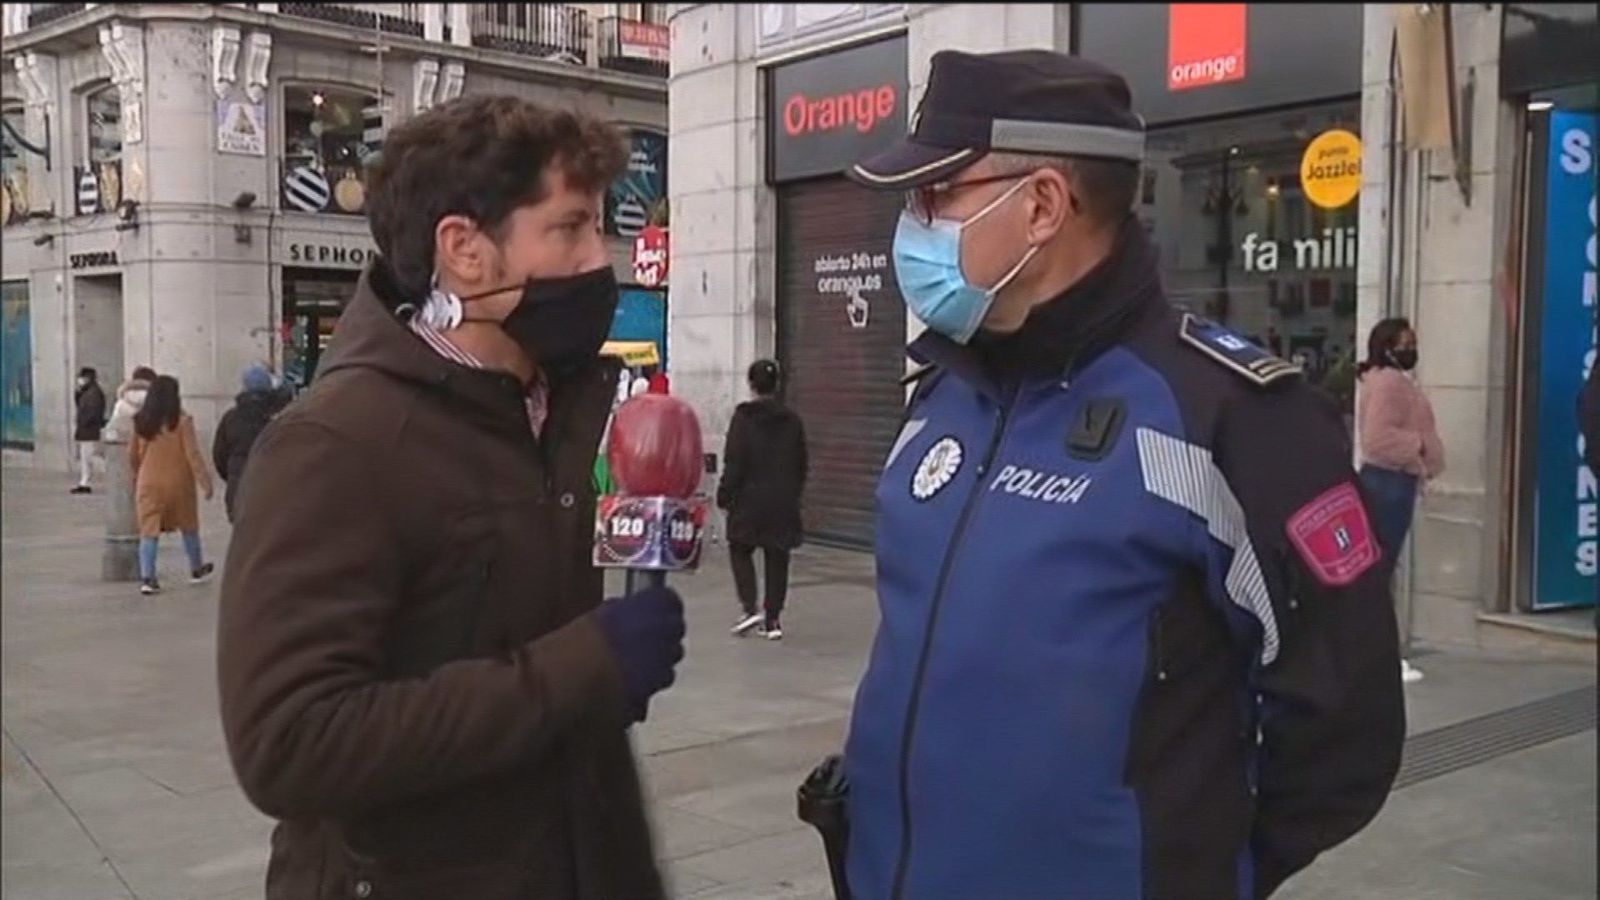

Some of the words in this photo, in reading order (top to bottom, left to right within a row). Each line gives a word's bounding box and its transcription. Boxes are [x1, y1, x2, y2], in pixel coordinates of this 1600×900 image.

[1171, 55, 1237, 81] orange
[783, 84, 896, 136] Orange
[815, 255, 850, 272] abierto
[852, 252, 871, 270] 24h
[872, 253, 887, 268] en
[817, 274, 882, 298] orange.es
[989, 464, 1092, 504] POLICÍA
[611, 515, 644, 536] 120
